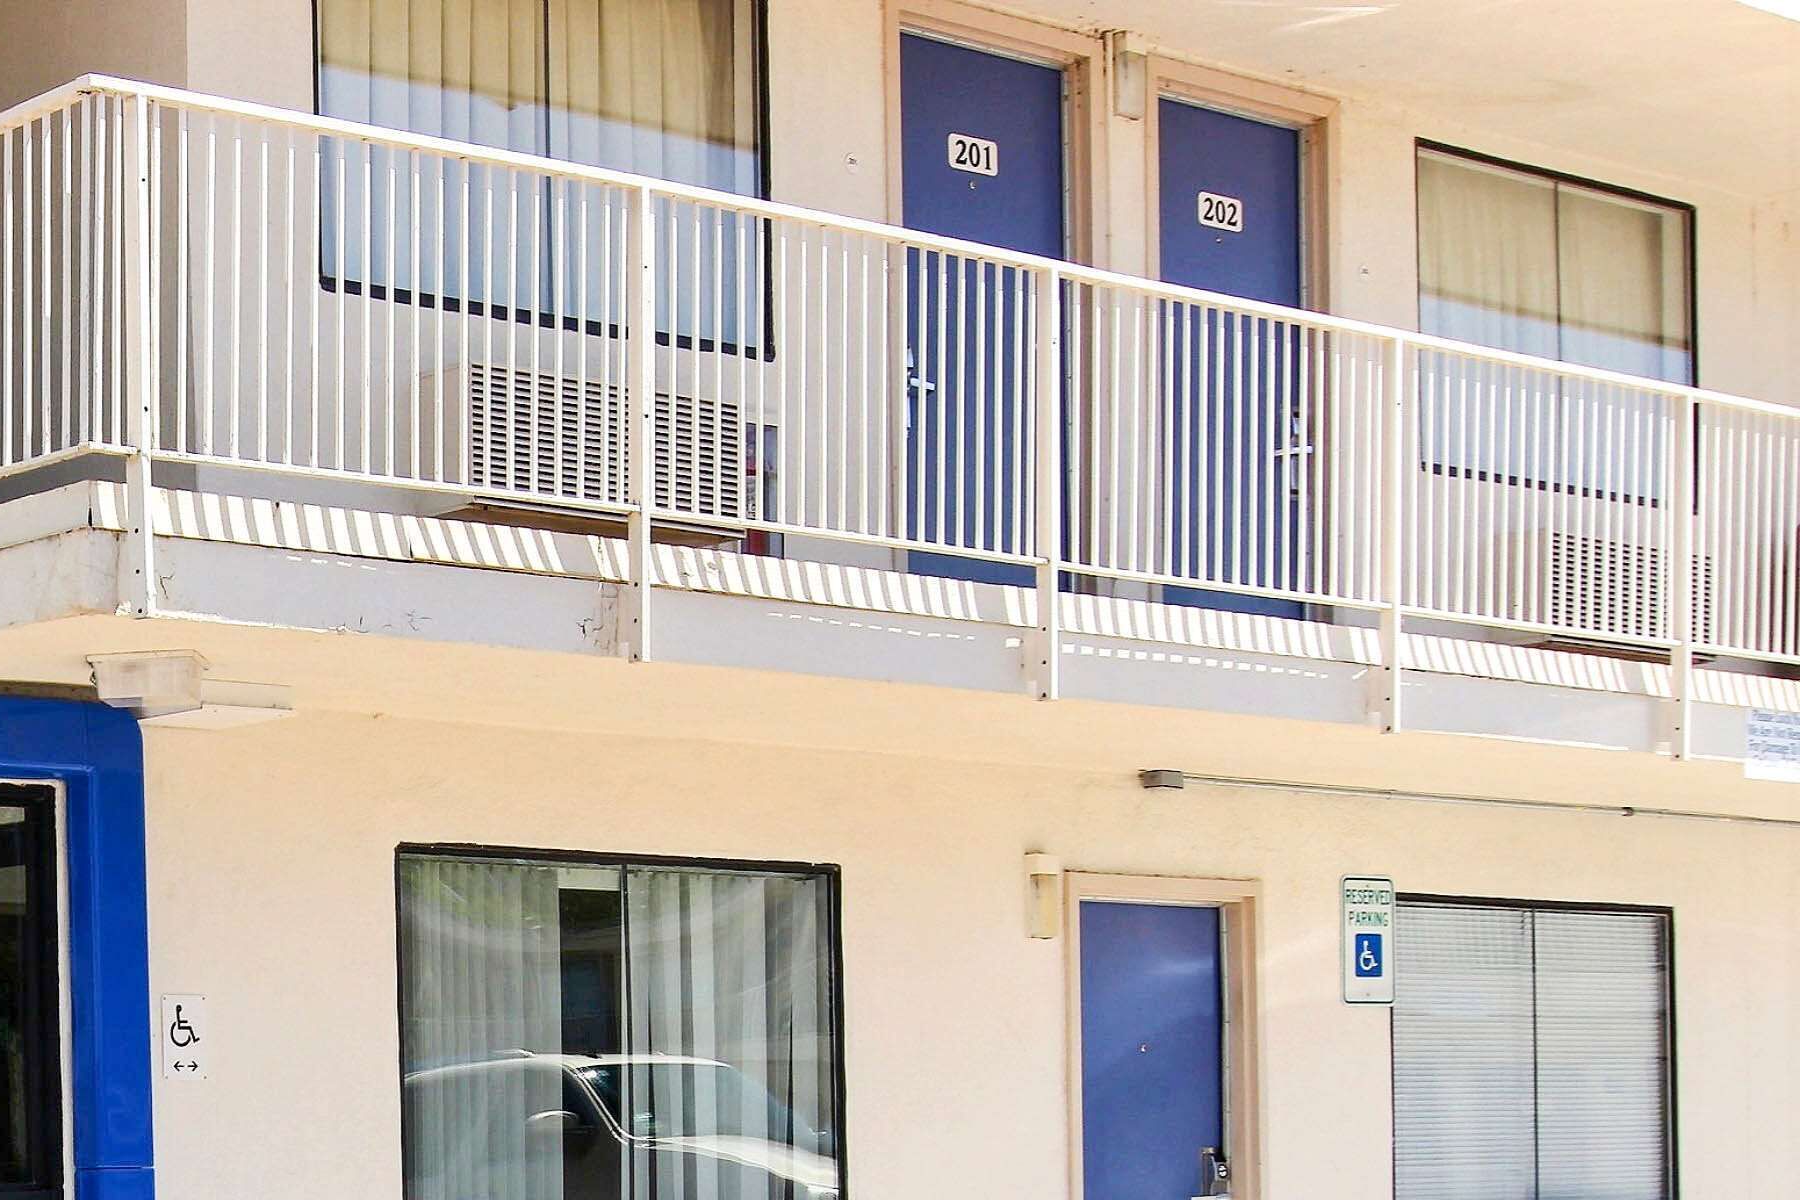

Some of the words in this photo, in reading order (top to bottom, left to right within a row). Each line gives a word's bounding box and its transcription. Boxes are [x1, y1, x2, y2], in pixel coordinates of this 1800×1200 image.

[955, 139, 993, 171] 201
[1202, 197, 1239, 228] 202
[1345, 888, 1391, 905] RESERVED
[1348, 911, 1388, 927] PARKING
